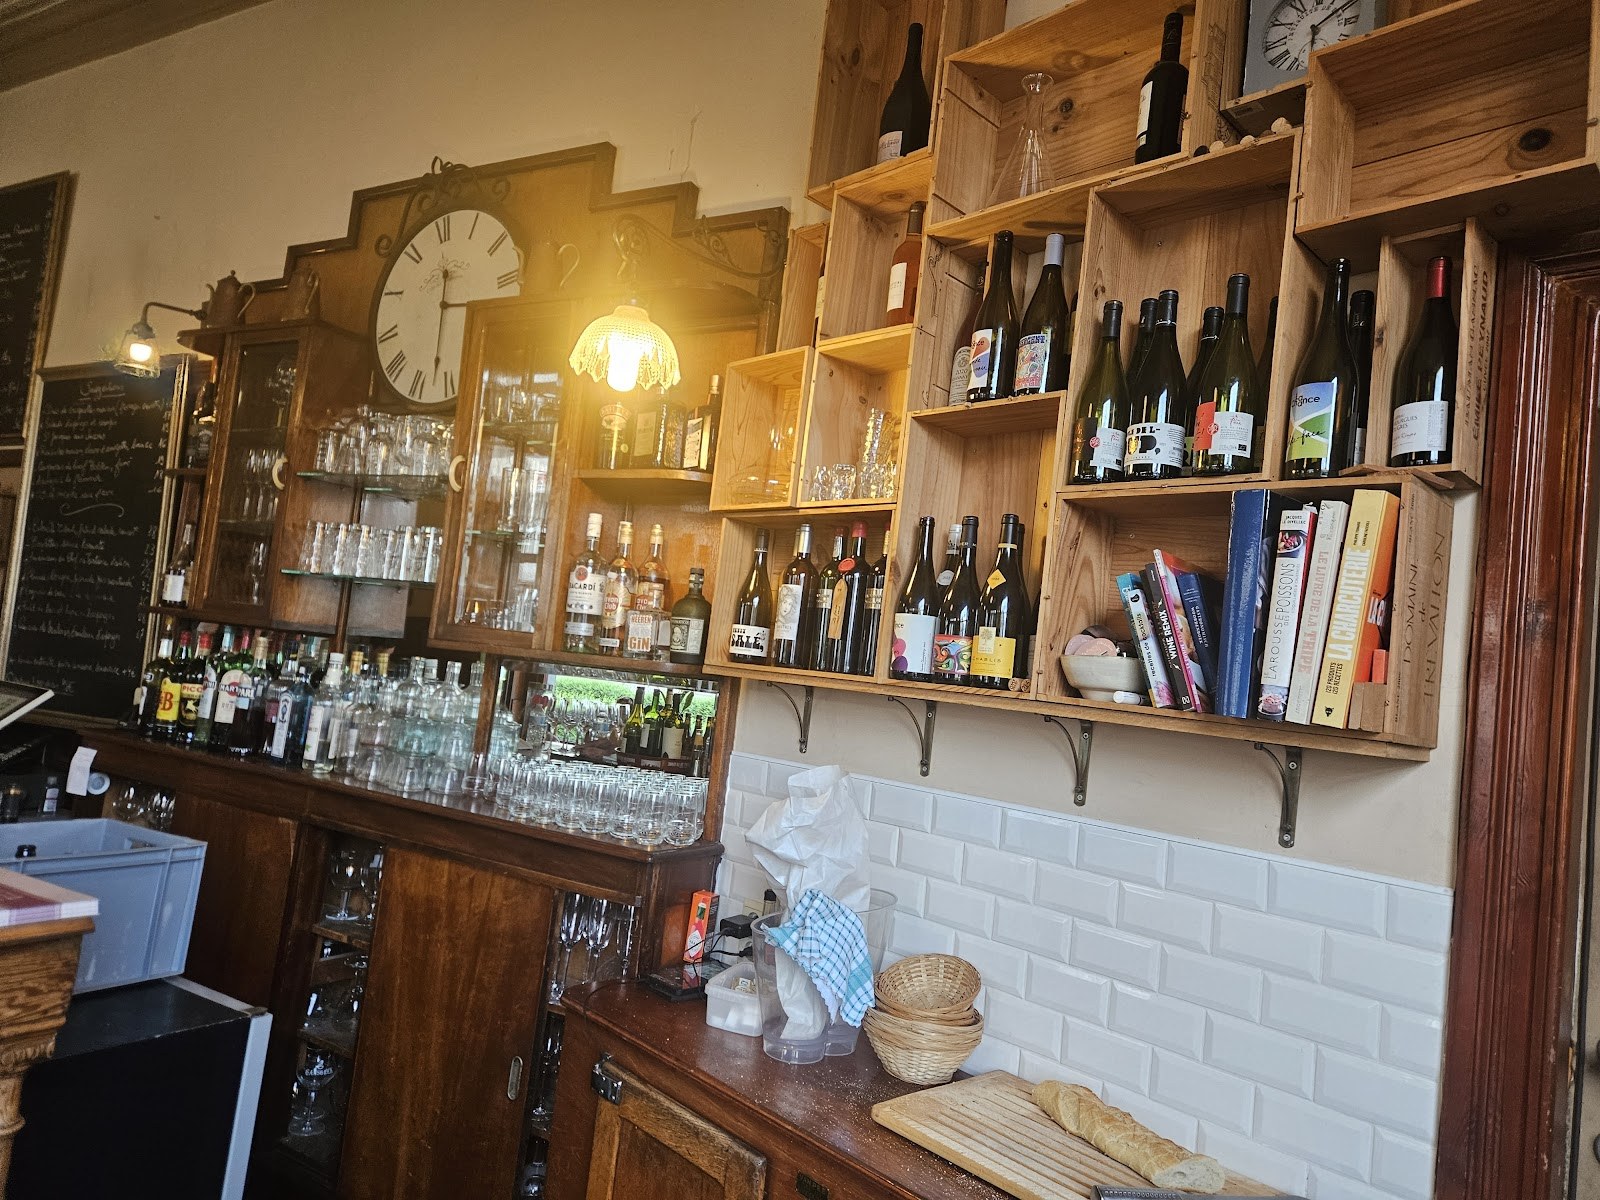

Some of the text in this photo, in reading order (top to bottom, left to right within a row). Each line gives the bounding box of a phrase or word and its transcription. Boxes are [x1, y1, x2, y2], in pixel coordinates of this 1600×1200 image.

[1318, 551, 1329, 564] LE
[1276, 562, 1295, 613] POISSONS
[1313, 566, 1327, 597] LIVRE
[1310, 598, 1322, 613] DE
[1326, 547, 1371, 661] LA CHARCUTERIE
[1419, 601, 1426, 623] de
[1136, 613, 1147, 640] cocktails
[1307, 613, 1319, 628] LA
[1143, 641, 1150, 651] de
[1159, 610, 1177, 659] WINE REMIX
[1267, 613, 1284, 680] LAROUSSE
[1298, 630, 1318, 674] TRIPE
[182, 685, 203, 693] PICO
[219, 684, 239, 692] MART
[1325, 661, 1337, 693] 120 PRODUITS
[1331, 662, 1344, 694] 120 RECETTES
[238, 687, 255, 699] PARI
